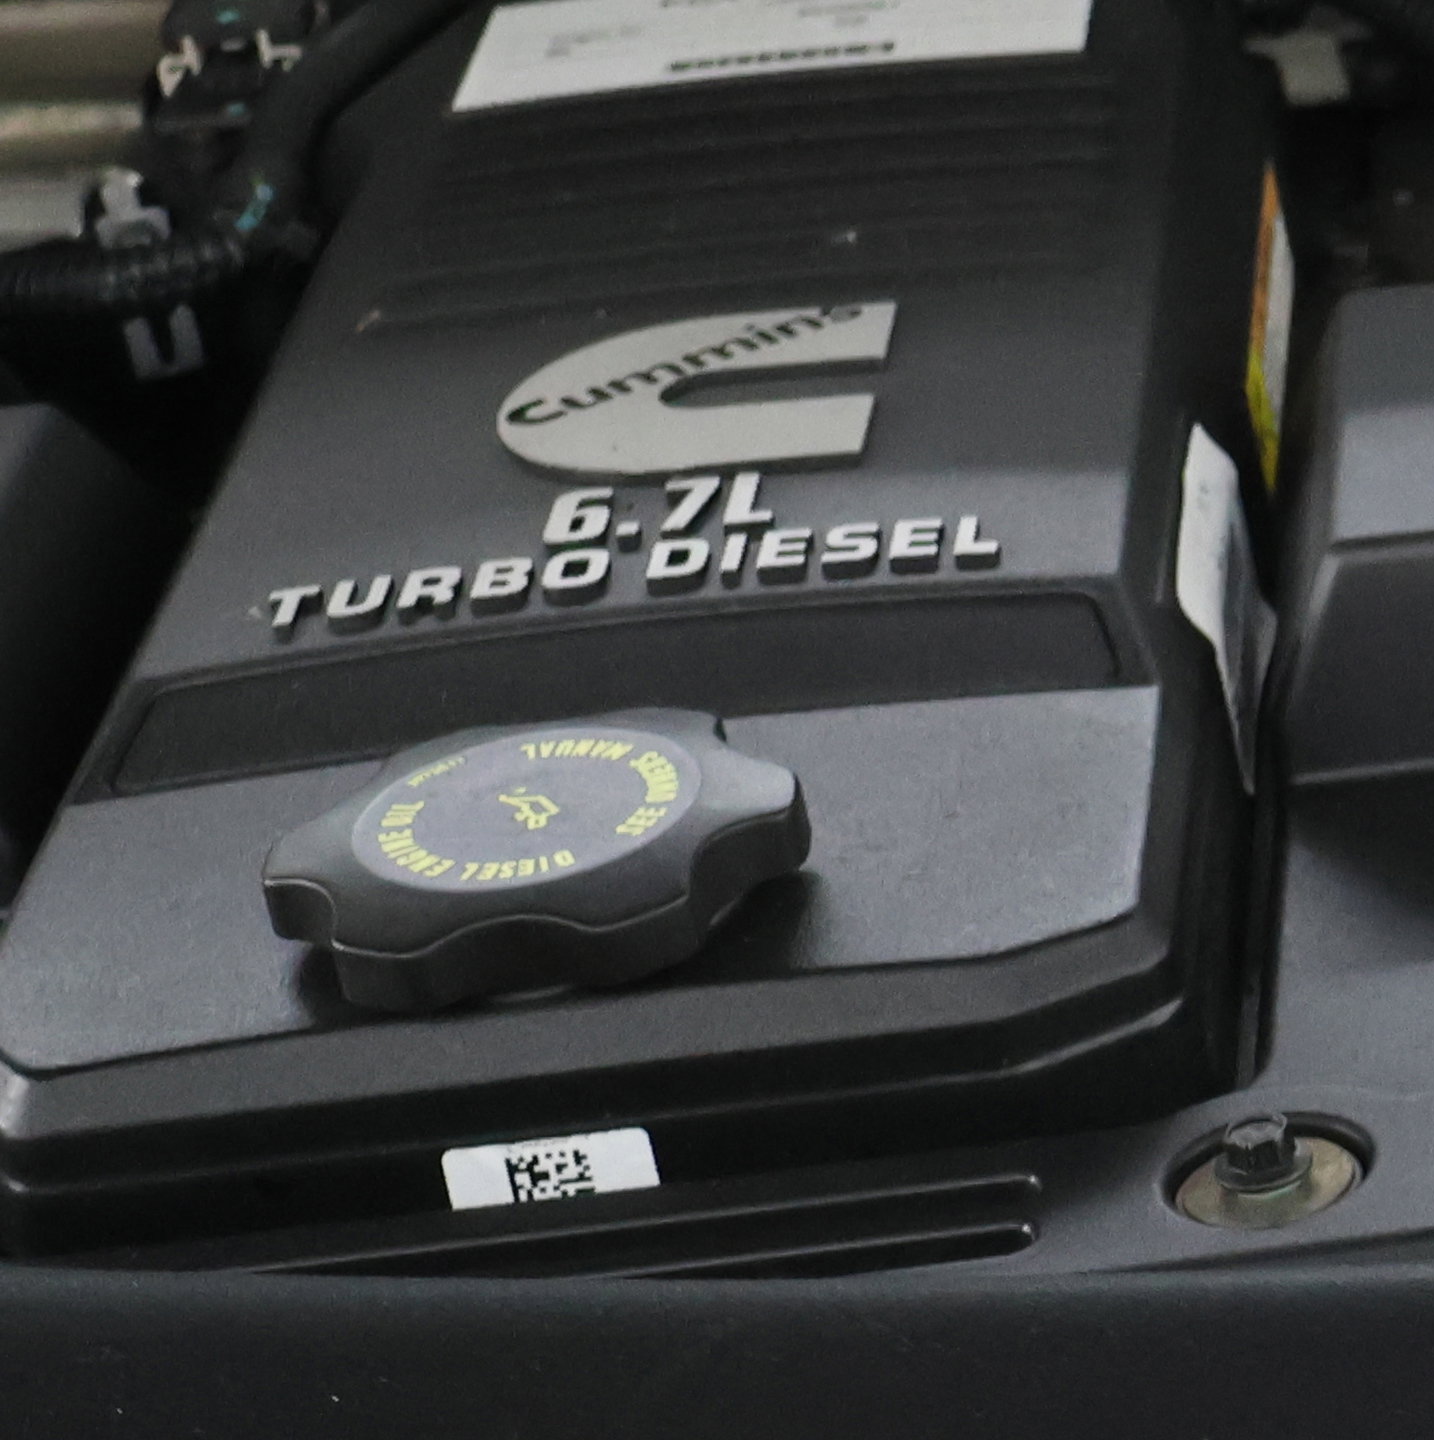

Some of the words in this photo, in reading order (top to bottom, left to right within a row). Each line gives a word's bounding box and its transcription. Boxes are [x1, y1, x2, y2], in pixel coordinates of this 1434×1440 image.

[506, 305, 864, 428] Cummins
[542, 471, 774, 546] 6.7L
[267, 547, 612, 628] TURBO
[645, 515, 1001, 583] DIESEL
[520, 738, 635, 761] MANUAL
[380, 800, 425, 828] OIL
[615, 806, 667, 837] SEE
[377, 827, 456, 878] ENGINE
[459, 849, 576, 881] DIESEL
